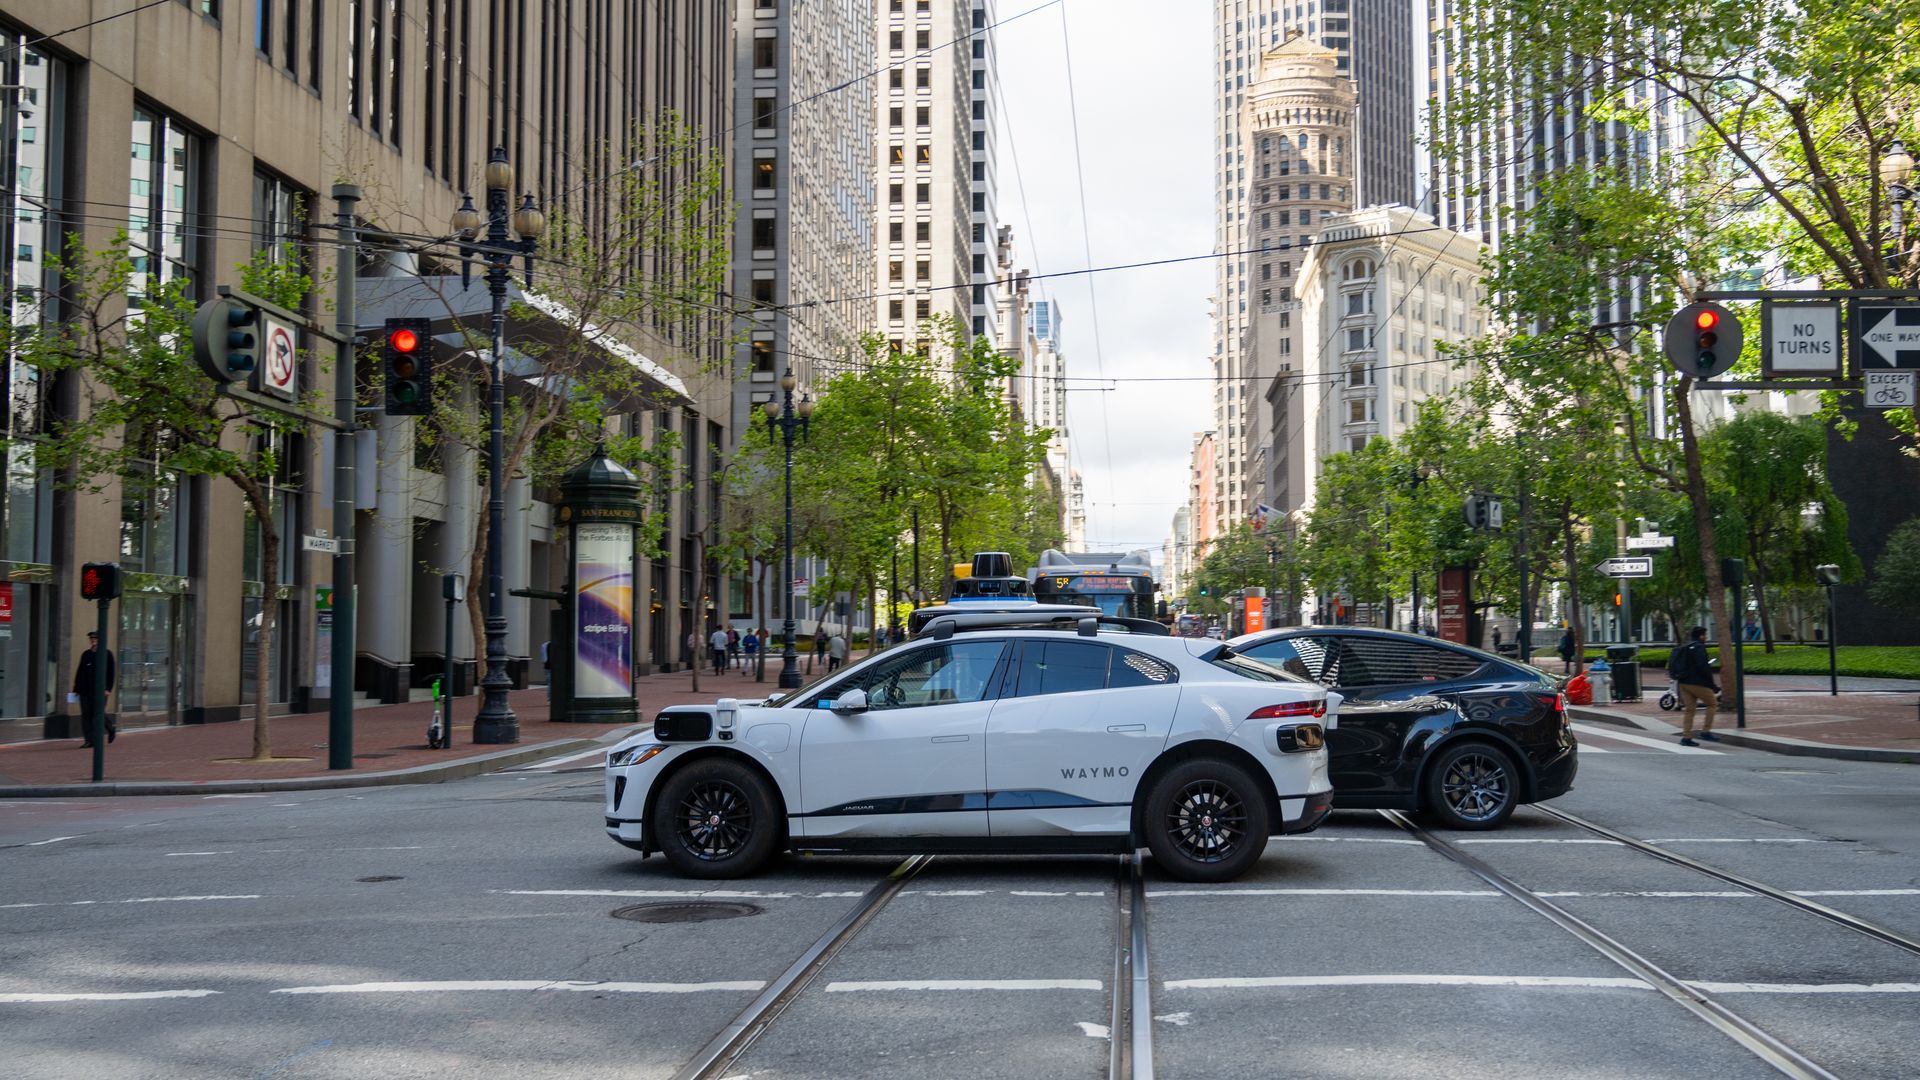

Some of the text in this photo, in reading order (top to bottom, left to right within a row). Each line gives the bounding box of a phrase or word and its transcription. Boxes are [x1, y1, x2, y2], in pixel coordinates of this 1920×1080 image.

[1793, 323, 1815, 337] NO
[1871, 332, 1920, 342] ONE WAY
[1778, 341, 1831, 354] TURNS
[1870, 374, 1910, 384] EXCEPT
[309, 539, 334, 550] MARKET
[1056, 577, 1069, 589] 5R
[584, 624, 628, 634] stripe Billing
[1060, 766, 1129, 779] WAYMO
